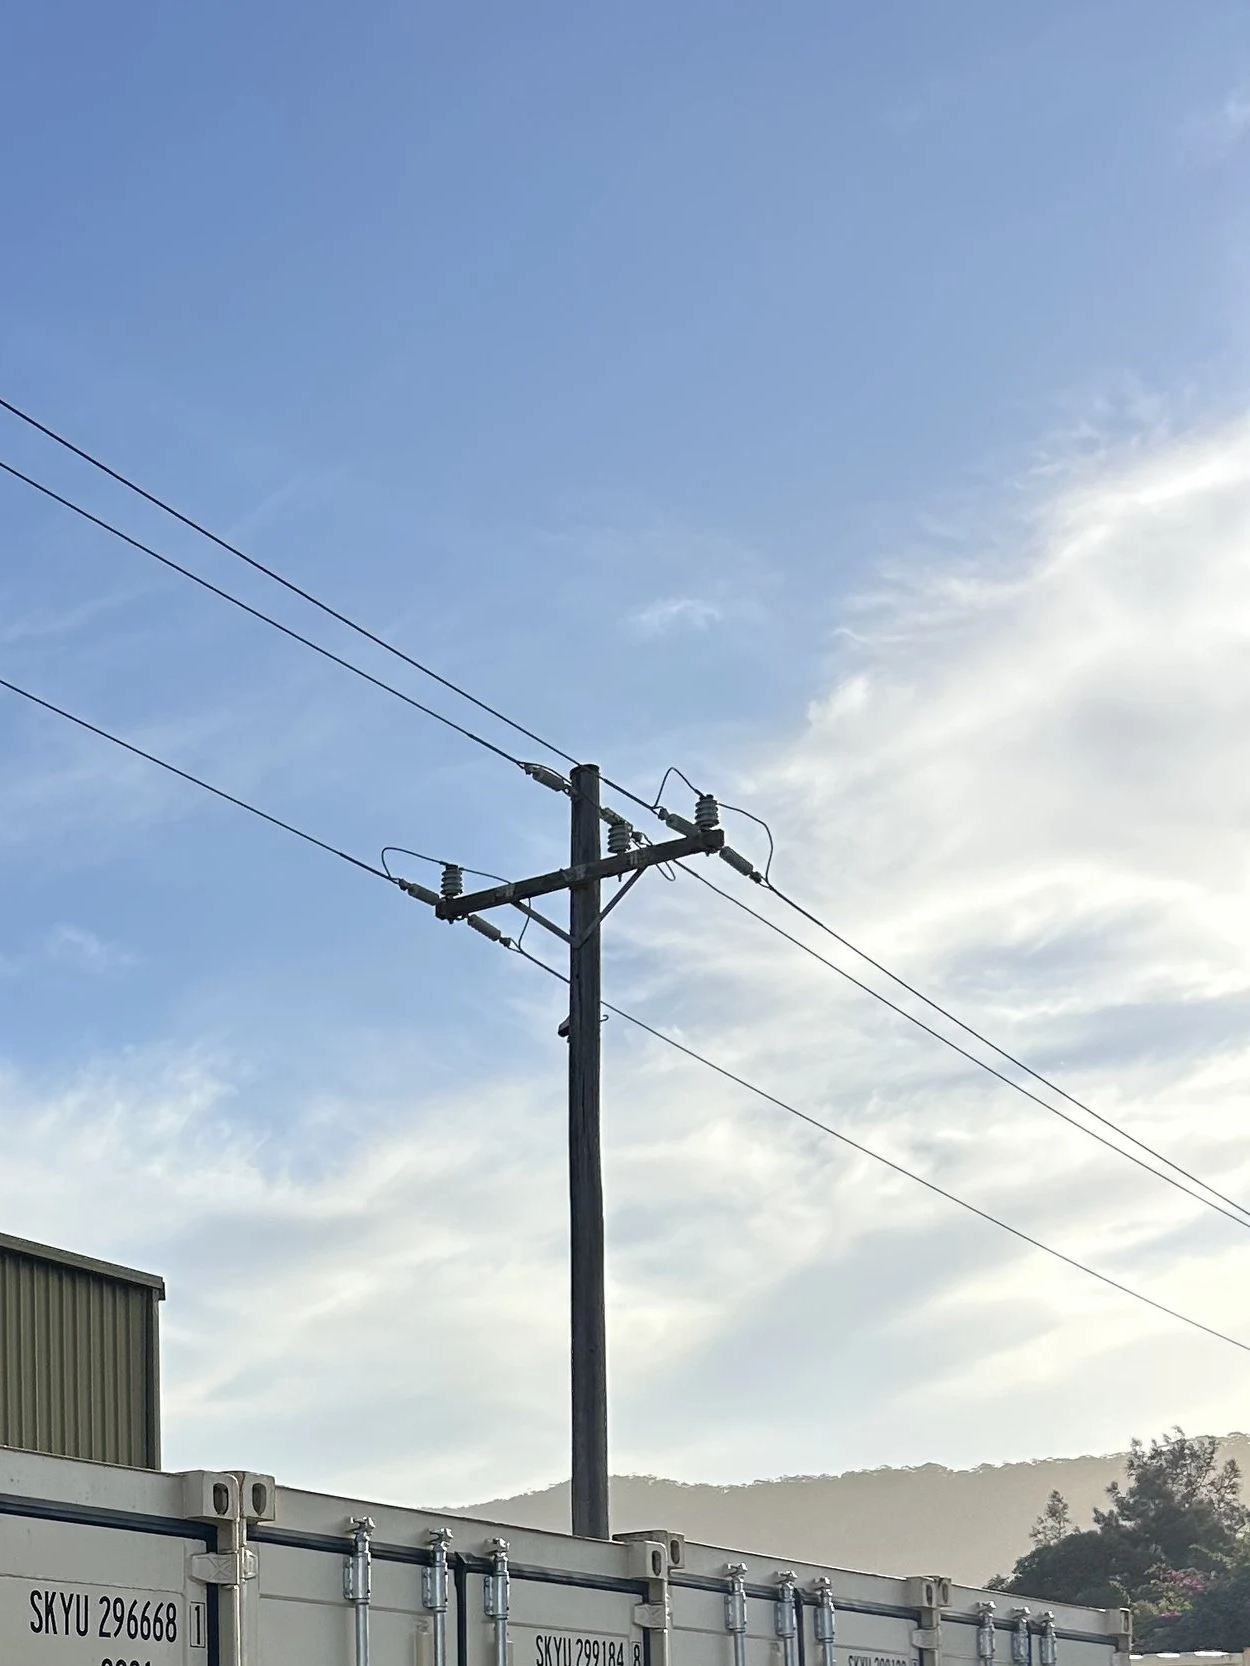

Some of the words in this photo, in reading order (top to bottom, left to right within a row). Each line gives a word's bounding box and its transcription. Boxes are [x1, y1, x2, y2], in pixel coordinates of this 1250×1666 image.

[30, 1590, 89, 1637] SKYU
[98, 1596, 177, 1642] 296668
[194, 1605, 201, 1646] 1
